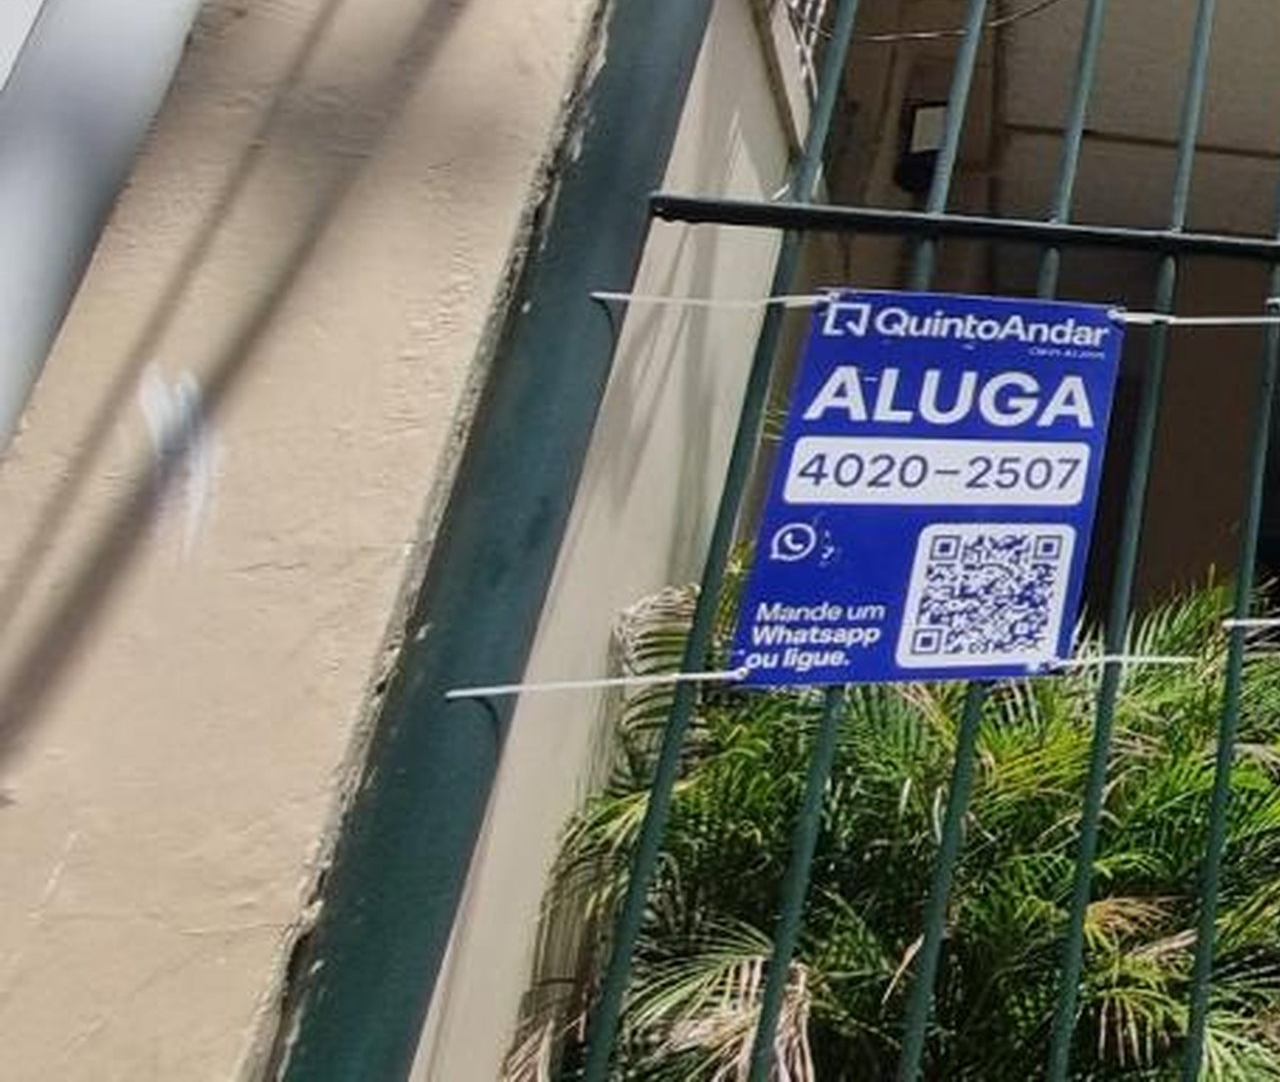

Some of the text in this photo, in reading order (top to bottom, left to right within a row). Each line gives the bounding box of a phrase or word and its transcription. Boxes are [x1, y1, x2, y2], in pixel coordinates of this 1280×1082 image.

[875, 307, 1109, 347] QuintoAndar
[803, 365, 1094, 428] ALUGA
[799, 453, 1082, 491] 4020-2507
[756, 602, 885, 622] Mande um
[751, 625, 881, 650] Whatsapp
[745, 649, 851, 676] ou ligue.
